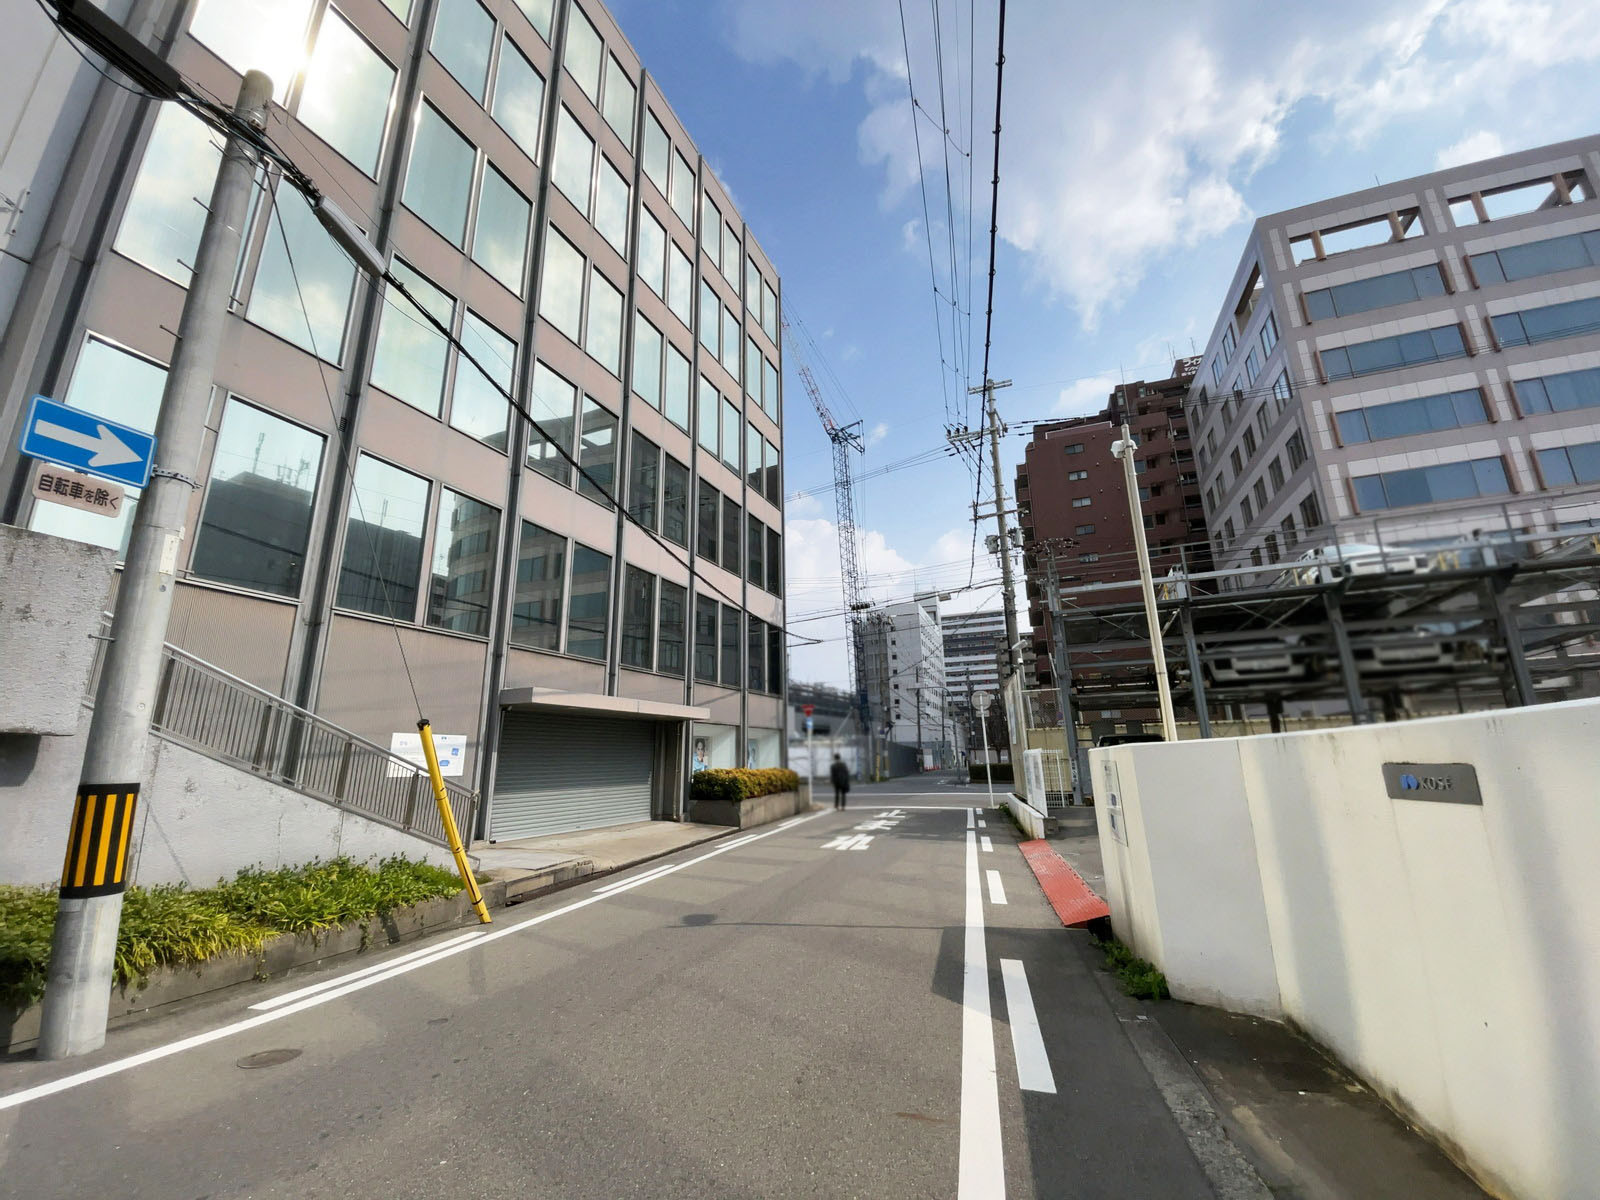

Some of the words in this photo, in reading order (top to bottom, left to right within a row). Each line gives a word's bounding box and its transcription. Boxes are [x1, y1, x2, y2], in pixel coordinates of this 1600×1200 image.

[37, 473, 120, 510] 自転車を除く
[820, 809, 907, 851] 止まれ
